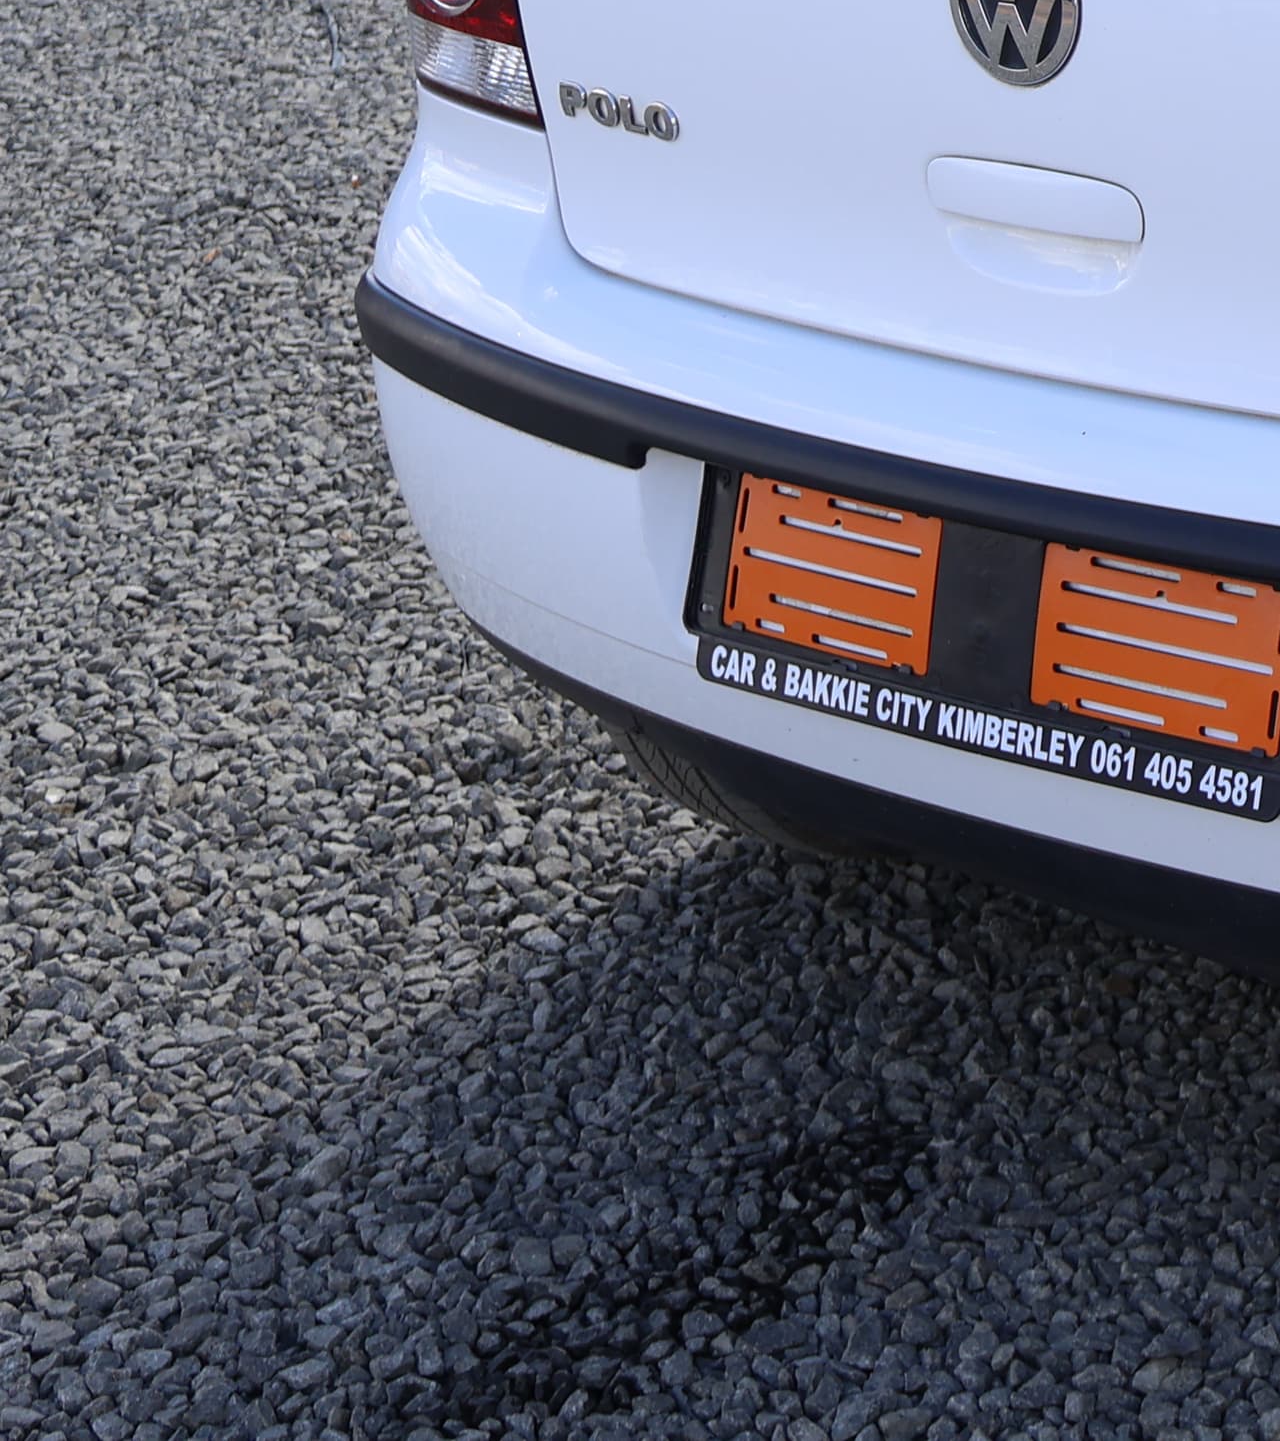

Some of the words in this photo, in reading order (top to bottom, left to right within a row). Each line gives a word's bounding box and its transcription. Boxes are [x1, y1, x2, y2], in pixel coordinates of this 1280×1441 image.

[558, 79, 680, 142] POLO
[711, 645, 756, 686] CAR
[761, 658, 777, 692] &
[783, 663, 871, 717] BAKKIE
[876, 688, 933, 731] CITY
[937, 702, 1085, 768] KIMBERLEY
[1090, 739, 1137, 782] 061
[1144, 751, 1193, 794] 405
[1199, 764, 1264, 811] 4581
